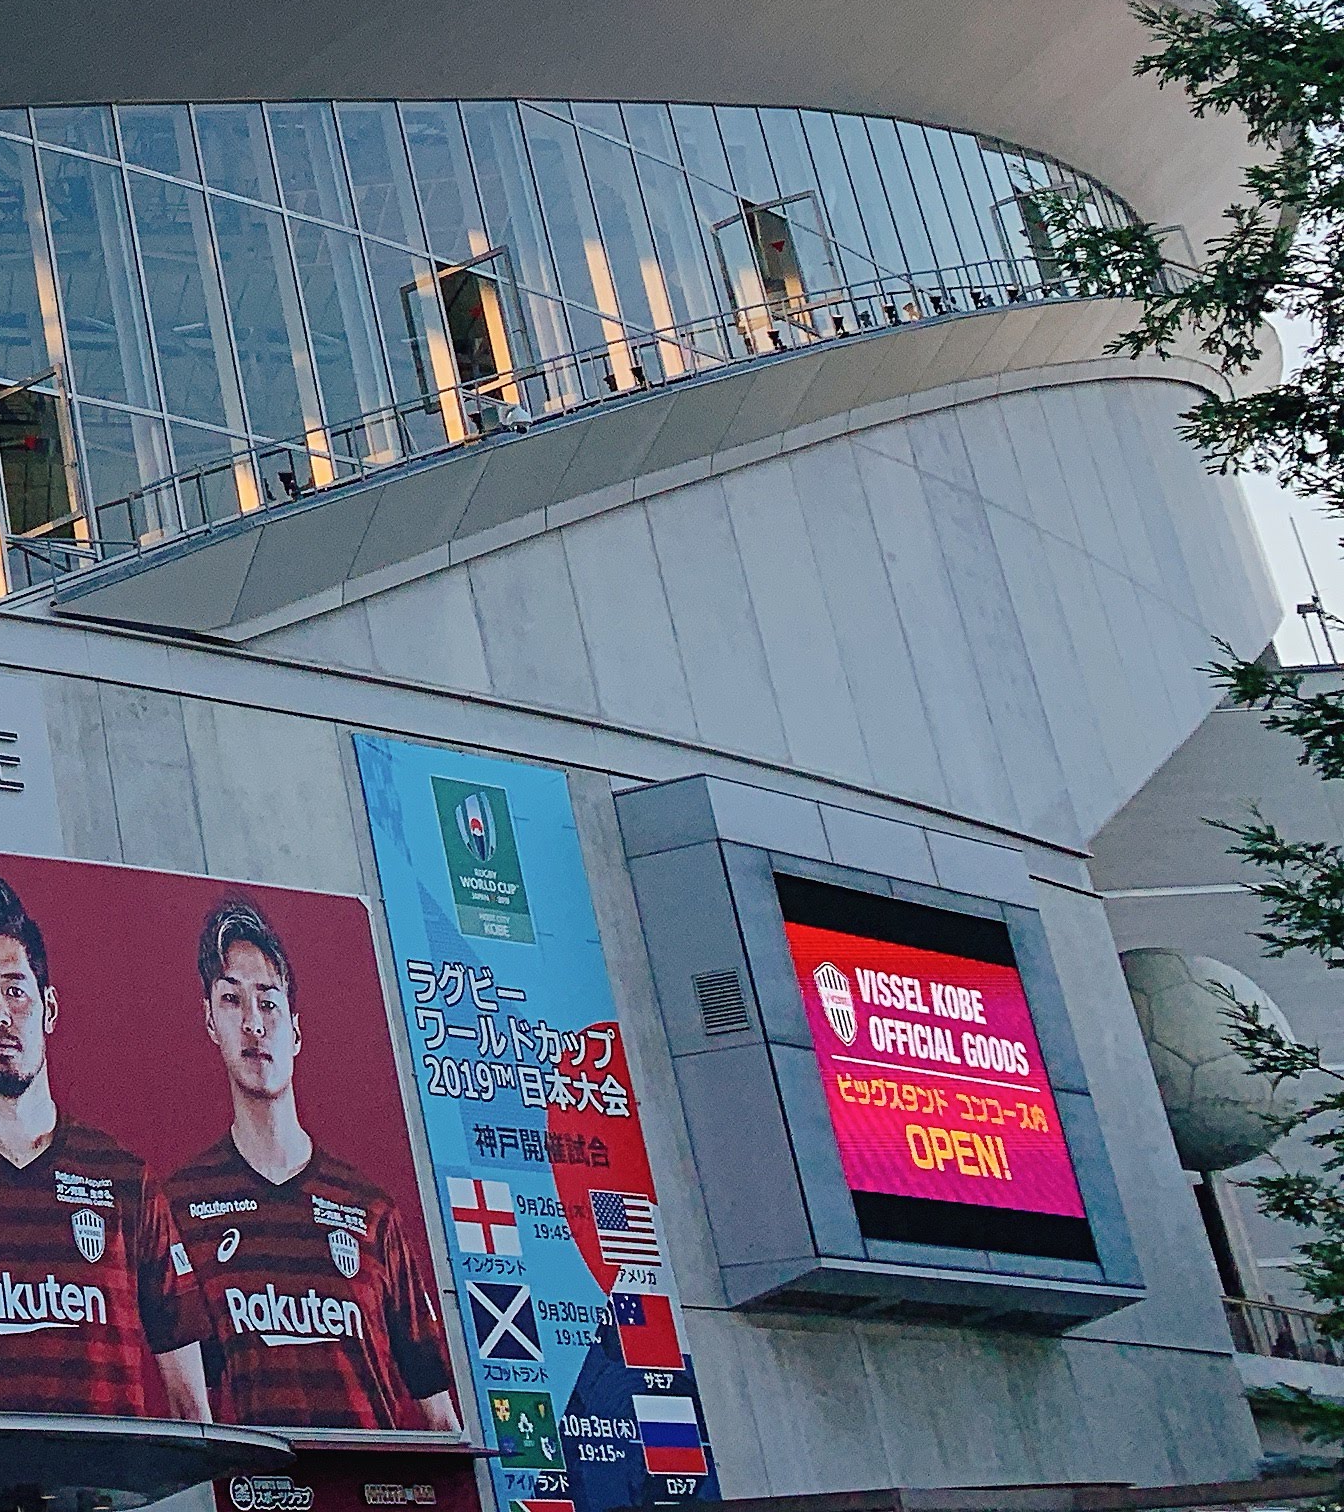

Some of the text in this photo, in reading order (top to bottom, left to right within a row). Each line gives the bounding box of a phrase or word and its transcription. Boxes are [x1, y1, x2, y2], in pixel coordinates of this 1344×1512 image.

[458, 875, 496, 893] WORLD
[483, 922, 511, 938] KOBE
[407, 959, 526, 1011] ラグビー
[854, 966, 987, 1025] VISSEL KOBE
[415, 1006, 616, 1070] ワールドカップ
[868, 1015, 1030, 1076] OFFICIAL GOODS
[836, 1072, 949, 1116] ビッグスタンド
[473, 1123, 610, 1168] 神戸開催試合
[905, 1123, 1013, 1181] OPEN!
[189, 1198, 258, 1217] Rakuten toto
[462, 1257, 527, 1276] イングランド
[618, 1268, 657, 1286] アメリカ
[225, 1283, 364, 1340] Rakuten
[482, 1364, 549, 1383] スコットランド
[643, 1372, 675, 1389] サモア
[504, 1473, 570, 1493] アイルランド
[666, 1478, 697, 1495] ロシア
